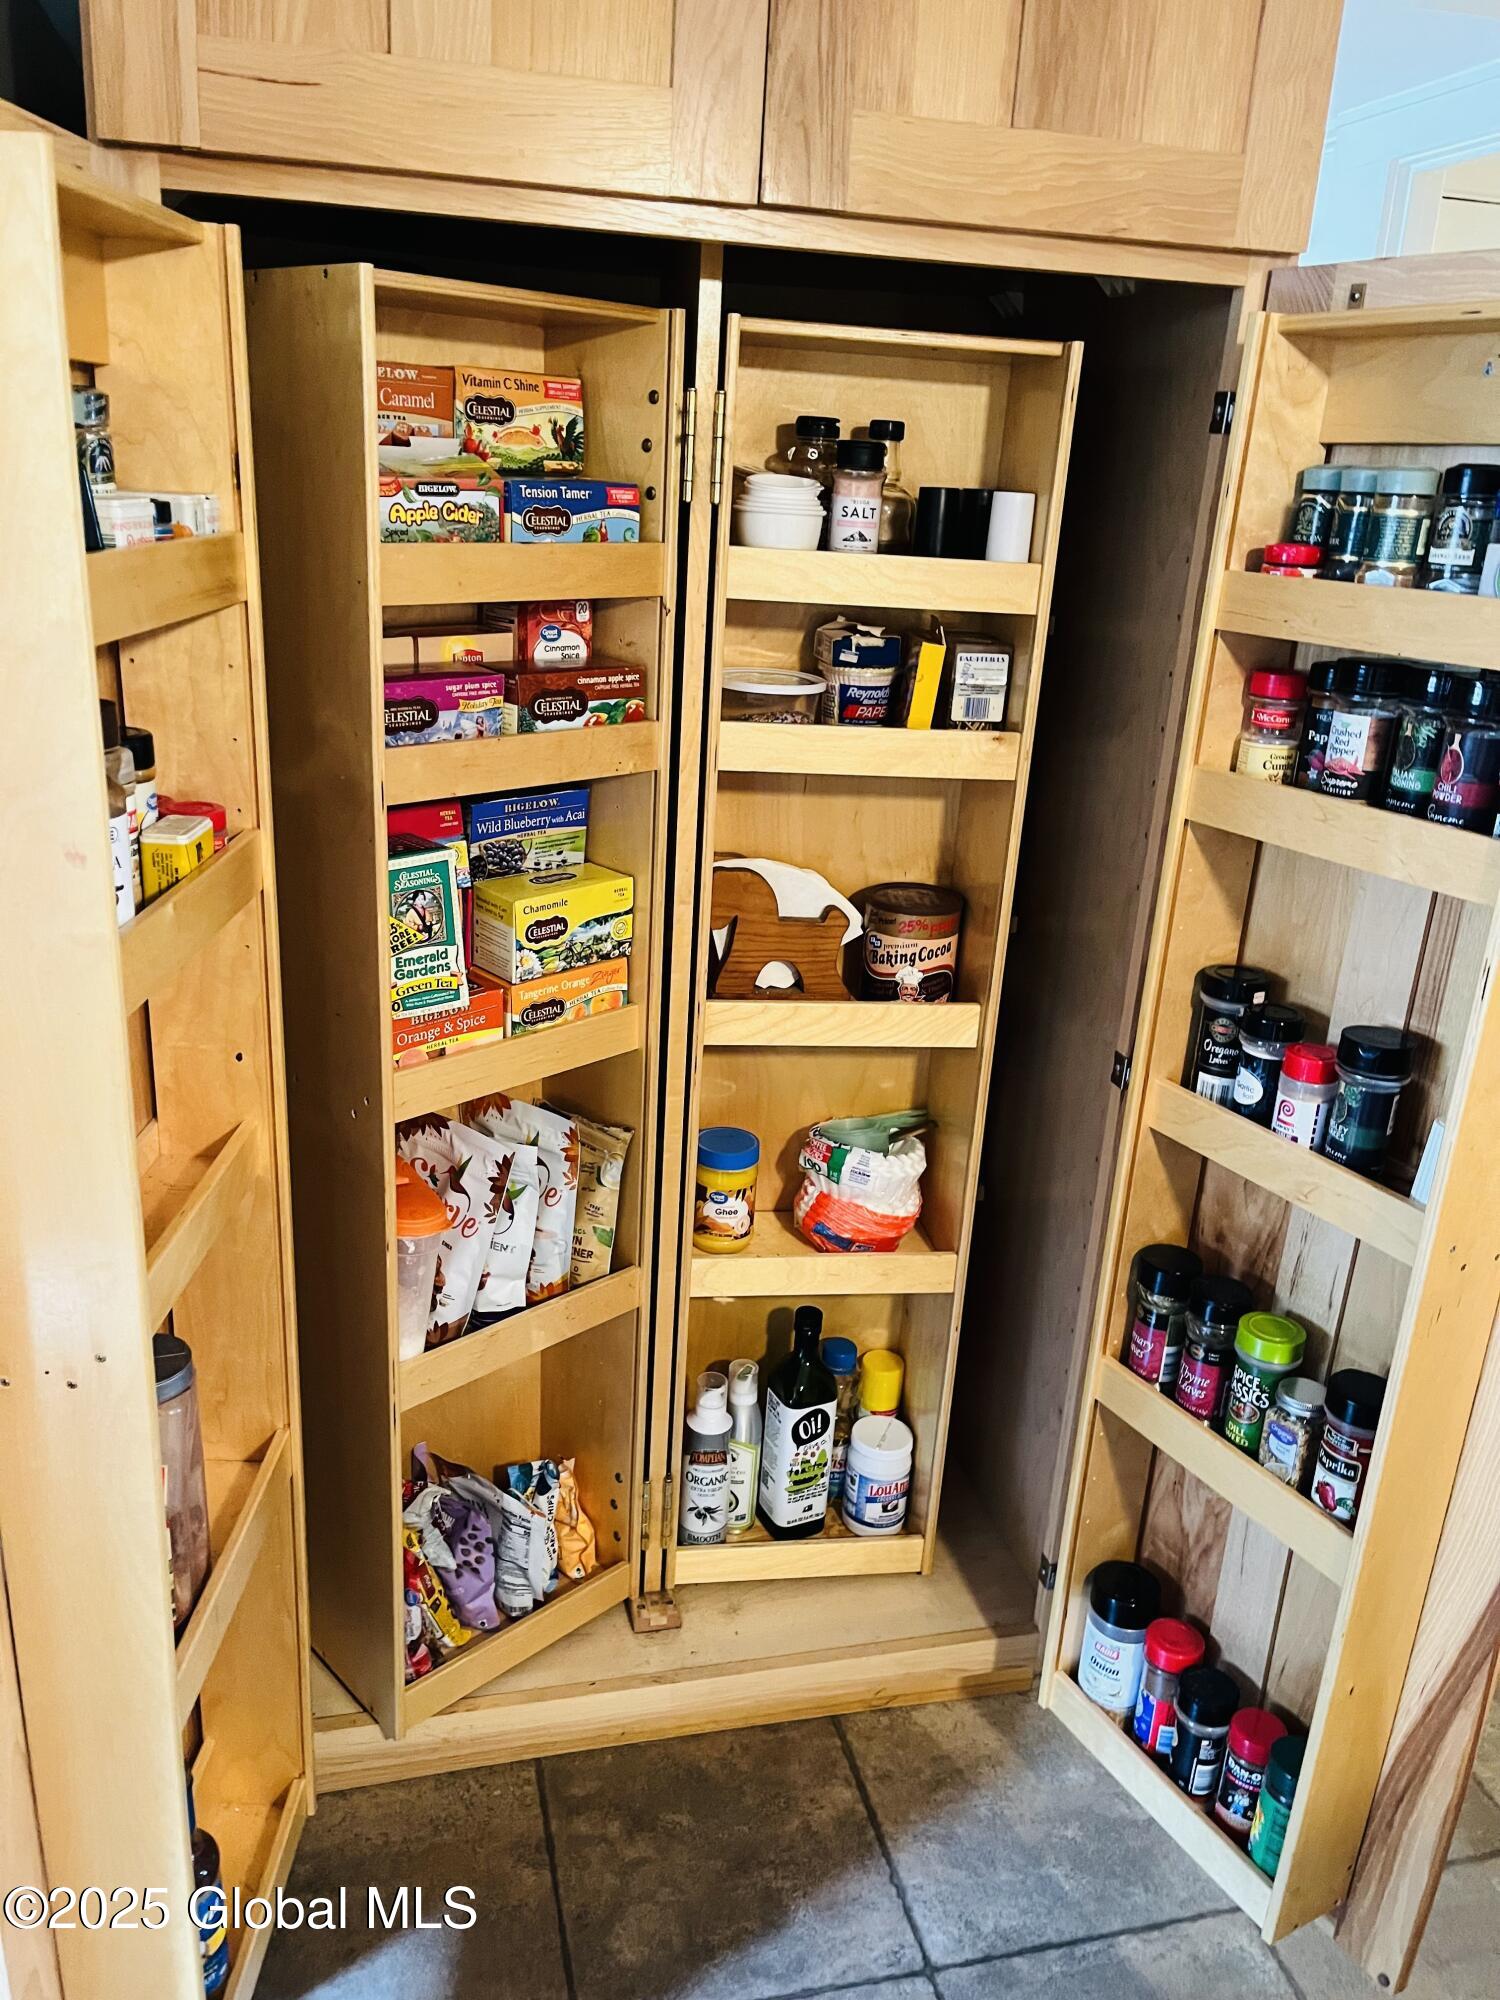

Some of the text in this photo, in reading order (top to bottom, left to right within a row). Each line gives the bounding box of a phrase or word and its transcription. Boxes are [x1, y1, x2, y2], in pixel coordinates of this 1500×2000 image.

[462, 373, 501, 388] Vitamin
[503, 377, 512, 390] C
[513, 378, 540, 392] Shine
[380, 388, 435, 409] Caramel
[466, 401, 511, 418] CELESTIAL
[418, 484, 457, 493] BIGELOW
[519, 484, 590, 499] Tension Tamer
[389, 500, 485, 527] Apple Cider
[525, 512, 569, 527] CELESTIAL
[841, 505, 877, 520] SALT
[578, 602, 588, 615] 20
[544, 644, 580, 653] Cinnamon
[454, 653, 482, 663] Lpton
[445, 681, 497, 693] sugar plum spice
[577, 672, 640, 685] cinnamon apple spice
[534, 699, 582, 715] CELESTIAL
[1308, 729, 1328, 745] Pap
[1331, 724, 1362, 739] Crushed
[1329, 742, 1355, 757] Pepper
[1334, 735, 1350, 747] Red
[1320, 770, 1359, 789] Supreme
[1437, 782, 1458, 794] CHILI
[1432, 788, 1463, 805] POWDER
[504, 798, 559, 813] BIGELOW
[476, 808, 585, 835] Wild Blueberry with Acai
[393, 872, 441, 892] SEASONINGS
[399, 868, 434, 882] CELESTIAL
[523, 898, 569, 915] Chamomile
[528, 922, 566, 940] CELESTIAL
[898, 919, 929, 934] 25%
[390, 928, 411, 945] ORE
[870, 940, 953, 968] Baking Cocoa
[883, 942, 918, 951] premium
[395, 947, 449, 969] Emerald
[394, 961, 451, 981] Gardens
[395, 978, 453, 997] Green Tea
[518, 984, 560, 1001] Tangerine
[561, 976, 591, 991] Orange
[523, 1004, 563, 1022] CELESTIAL
[396, 1014, 486, 1046] Orange & Spice
[426, 1040, 447, 1050] HERBAL
[1203, 1038, 1239, 1058] Oregano
[1208, 1053, 1228, 1065] Leaves
[714, 1208, 739, 1216] Ghee
[1180, 1359, 1211, 1388] Thyme
[1233, 1364, 1261, 1392] SPICE
[1178, 1371, 1207, 1400] Leaves
[798, 1413, 822, 1440] Oi!
[1228, 1420, 1246, 1438] DILL
[1225, 1426, 1249, 1448] WEED
[1319, 1448, 1355, 1478] Paprika
[685, 1471, 729, 1487] ORGANIC
[687, 1532, 721, 1543] SMOOTH
[1090, 1655, 1120, 1677] Onion
